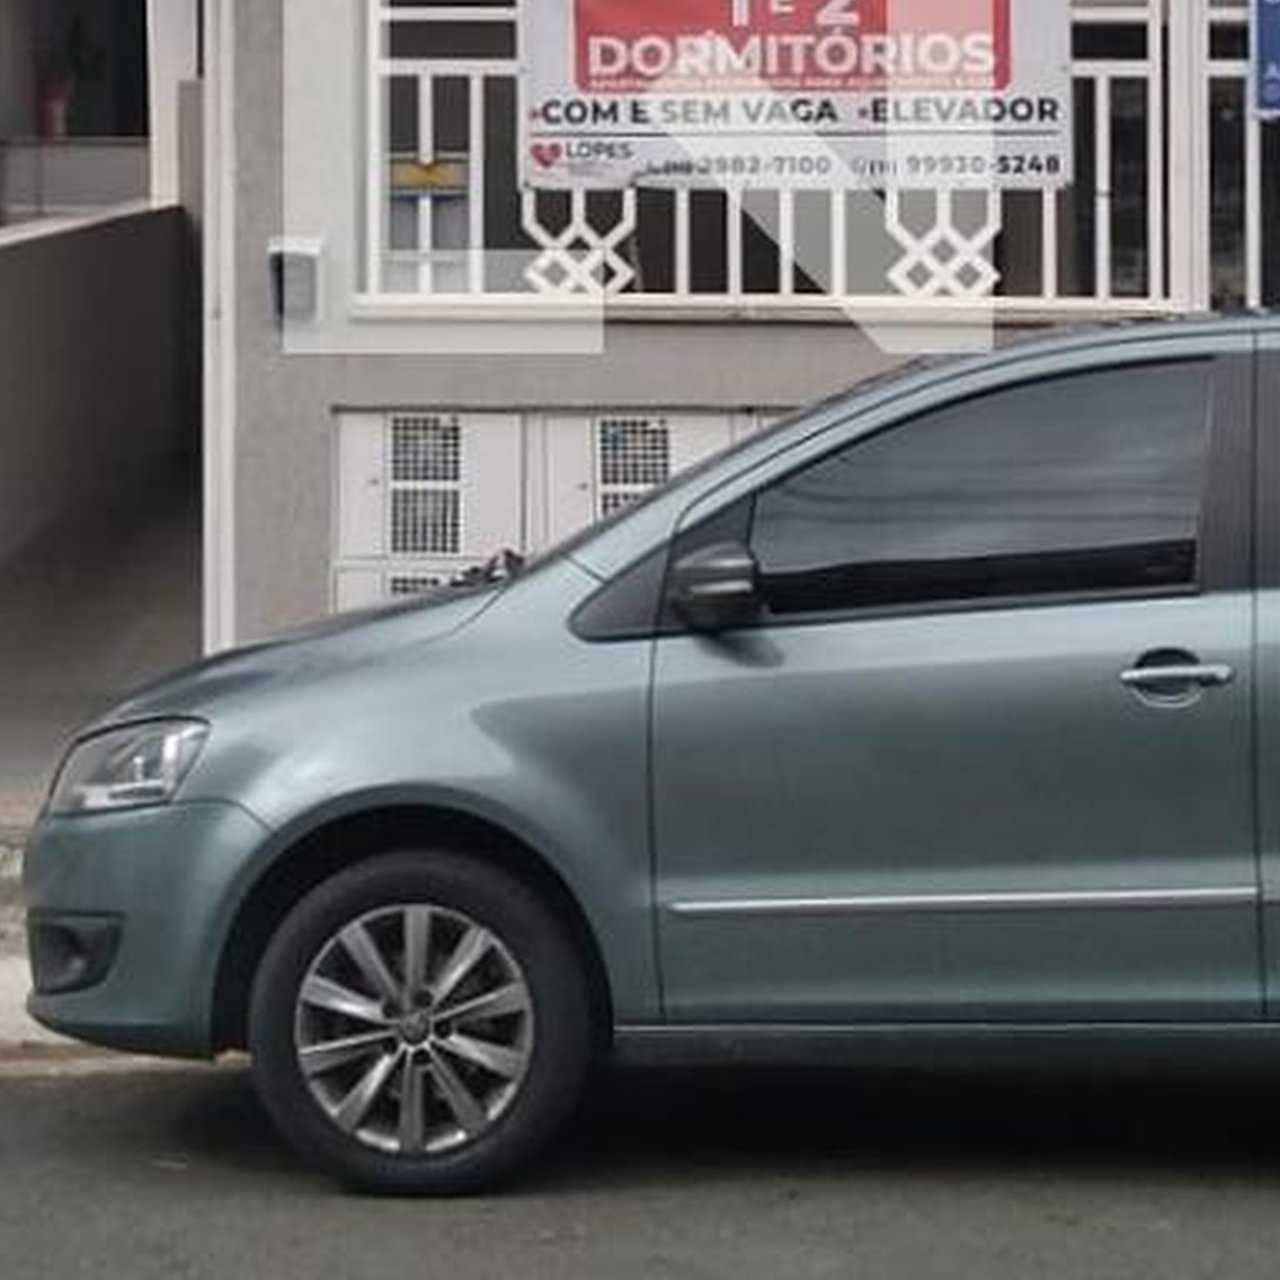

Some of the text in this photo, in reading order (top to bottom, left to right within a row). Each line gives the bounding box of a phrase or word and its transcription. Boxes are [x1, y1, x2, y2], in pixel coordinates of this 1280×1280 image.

[586, 26, 995, 74] DORMITÓRIOS
[541, 98, 1060, 125] COM E SEM VAGA ELEVADOR
[566, 141, 633, 159] LOPES
